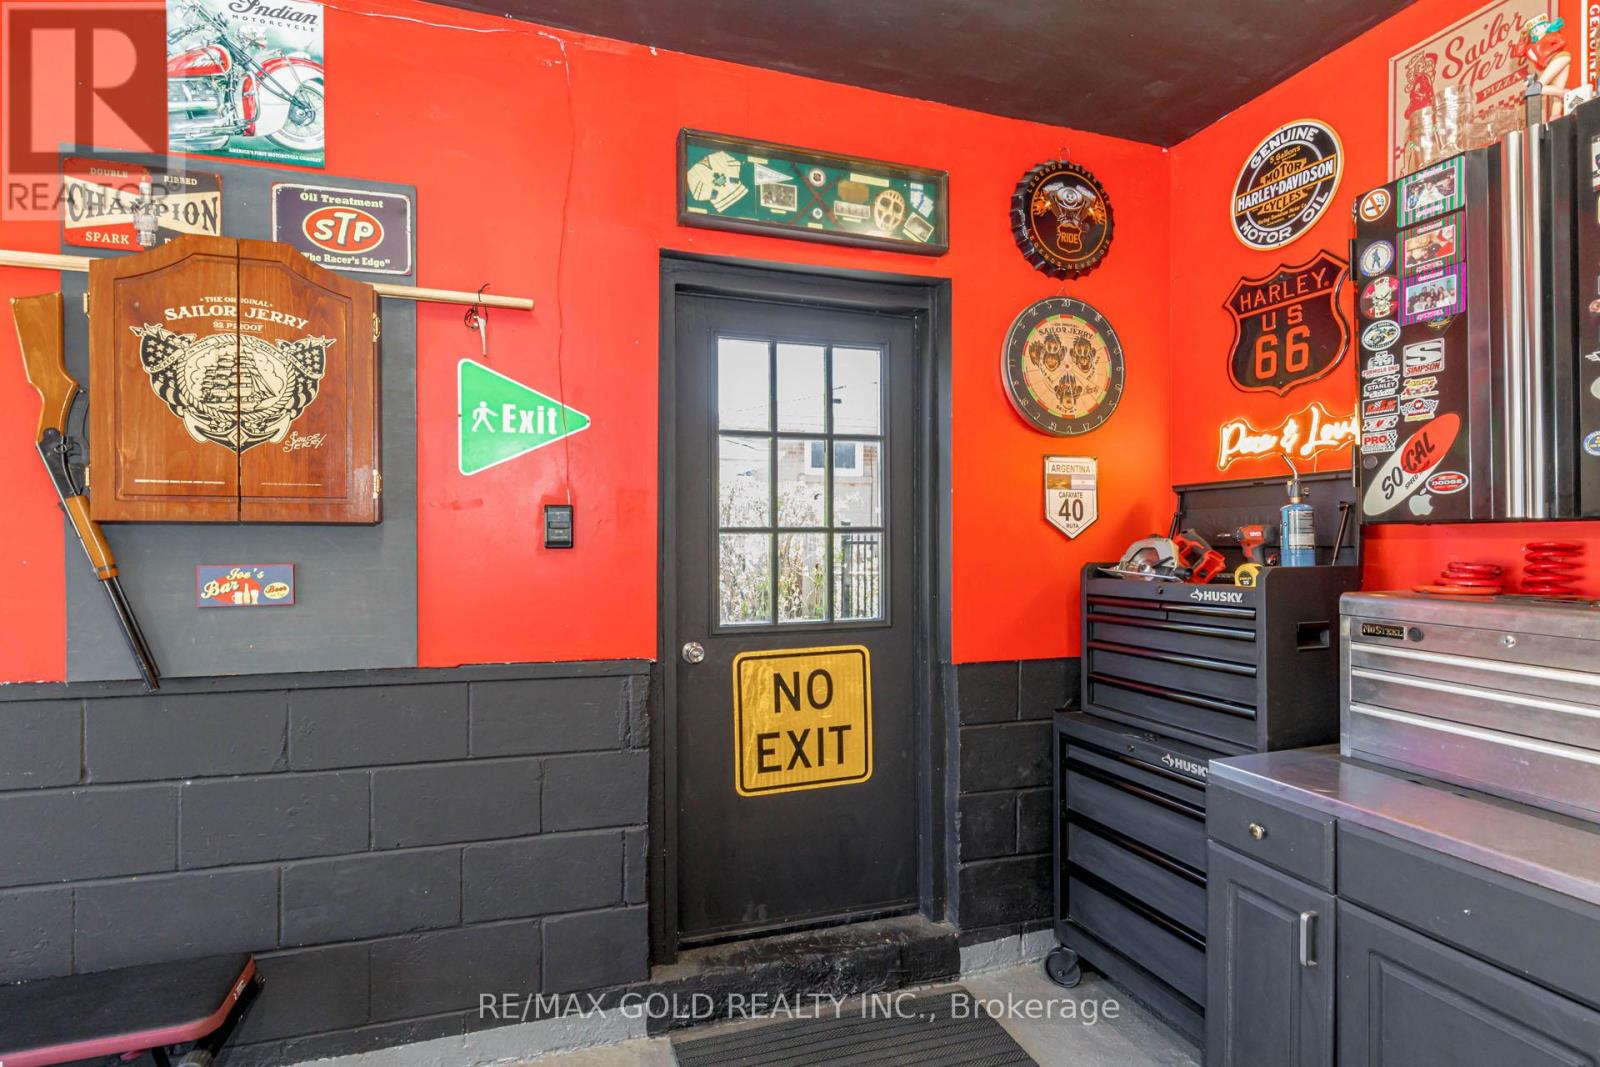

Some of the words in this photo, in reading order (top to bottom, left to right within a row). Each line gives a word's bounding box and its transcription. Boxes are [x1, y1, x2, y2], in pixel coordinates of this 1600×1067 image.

[228, 0, 318, 25] Indian
[232, 14, 315, 33] MOTORCYCLE
[1442, 11, 1528, 80] Sailor
[1250, 126, 1319, 169] GENUINE
[90, 167, 129, 178] DOUBLE
[164, 175, 198, 186] RIBBED
[1264, 161, 1303, 184] MOTOR
[67, 182, 220, 235] CHAMPION
[300, 192, 318, 202] Oil
[321, 194, 384, 208] Treatment
[1263, 190, 1302, 212] CYCLES
[1302, 191, 1329, 223] OIL
[85, 231, 130, 245] SPARK
[313, 211, 375, 245] STP
[1060, 231, 1079, 245] RIDE
[1240, 221, 1293, 243] MOTOR
[323, 253, 360, 265] Racer's
[164, 304, 237, 321] SAILOR
[244, 306, 309, 330] JERRY
[213, 321, 225, 330] 92
[1261, 311, 1277, 332] U
[1286, 303, 1304, 325] S
[1255, 324, 1310, 380] 66
[1406, 362, 1442, 375] SIMPSON
[1367, 381, 1397, 391] STANLEY
[502, 403, 557, 435] Exit
[1364, 434, 1388, 445] PRO
[1405, 431, 1435, 471] CAL
[1050, 464, 1091, 473] ARGENTINA
[1381, 466, 1404, 500] SO
[1431, 478, 1463, 486] DODGE
[1058, 498, 1085, 522] 40
[226, 567, 265, 580] Joe's
[200, 580, 239, 599] Bar
[1203, 590, 1243, 603] HUSKY
[773, 668, 833, 713] NO
[757, 724, 852, 774] EXIT
[1174, 757, 1208, 777] HUSK
